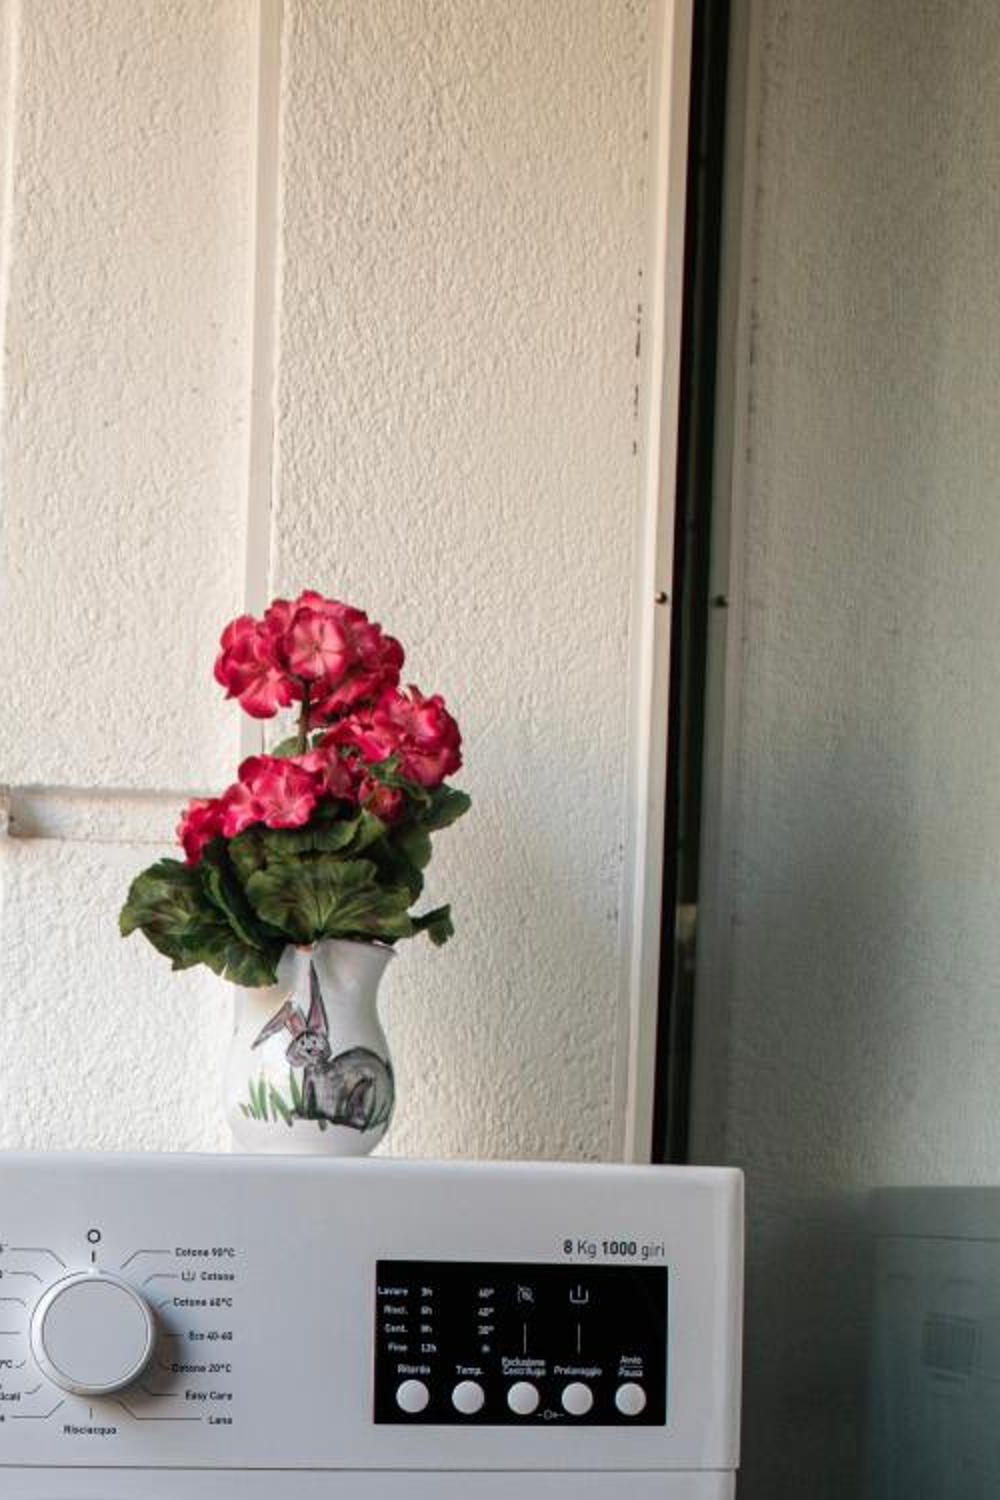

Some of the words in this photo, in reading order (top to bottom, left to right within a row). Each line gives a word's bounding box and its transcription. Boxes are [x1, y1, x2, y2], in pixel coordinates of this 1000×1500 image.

[175, 1247, 209, 1257] Cotone
[563, 1239, 573, 1254] 8
[577, 1240, 597, 1258] Kg
[602, 1241, 637, 1256] 1000
[641, 1242, 665, 1260] giri
[200, 1271, 235, 1281] Cotone
[173, 1297, 207, 1307] Cotone
[185, 1389, 208, 1402] Easy
[209, 1390, 233, 1401] Care
